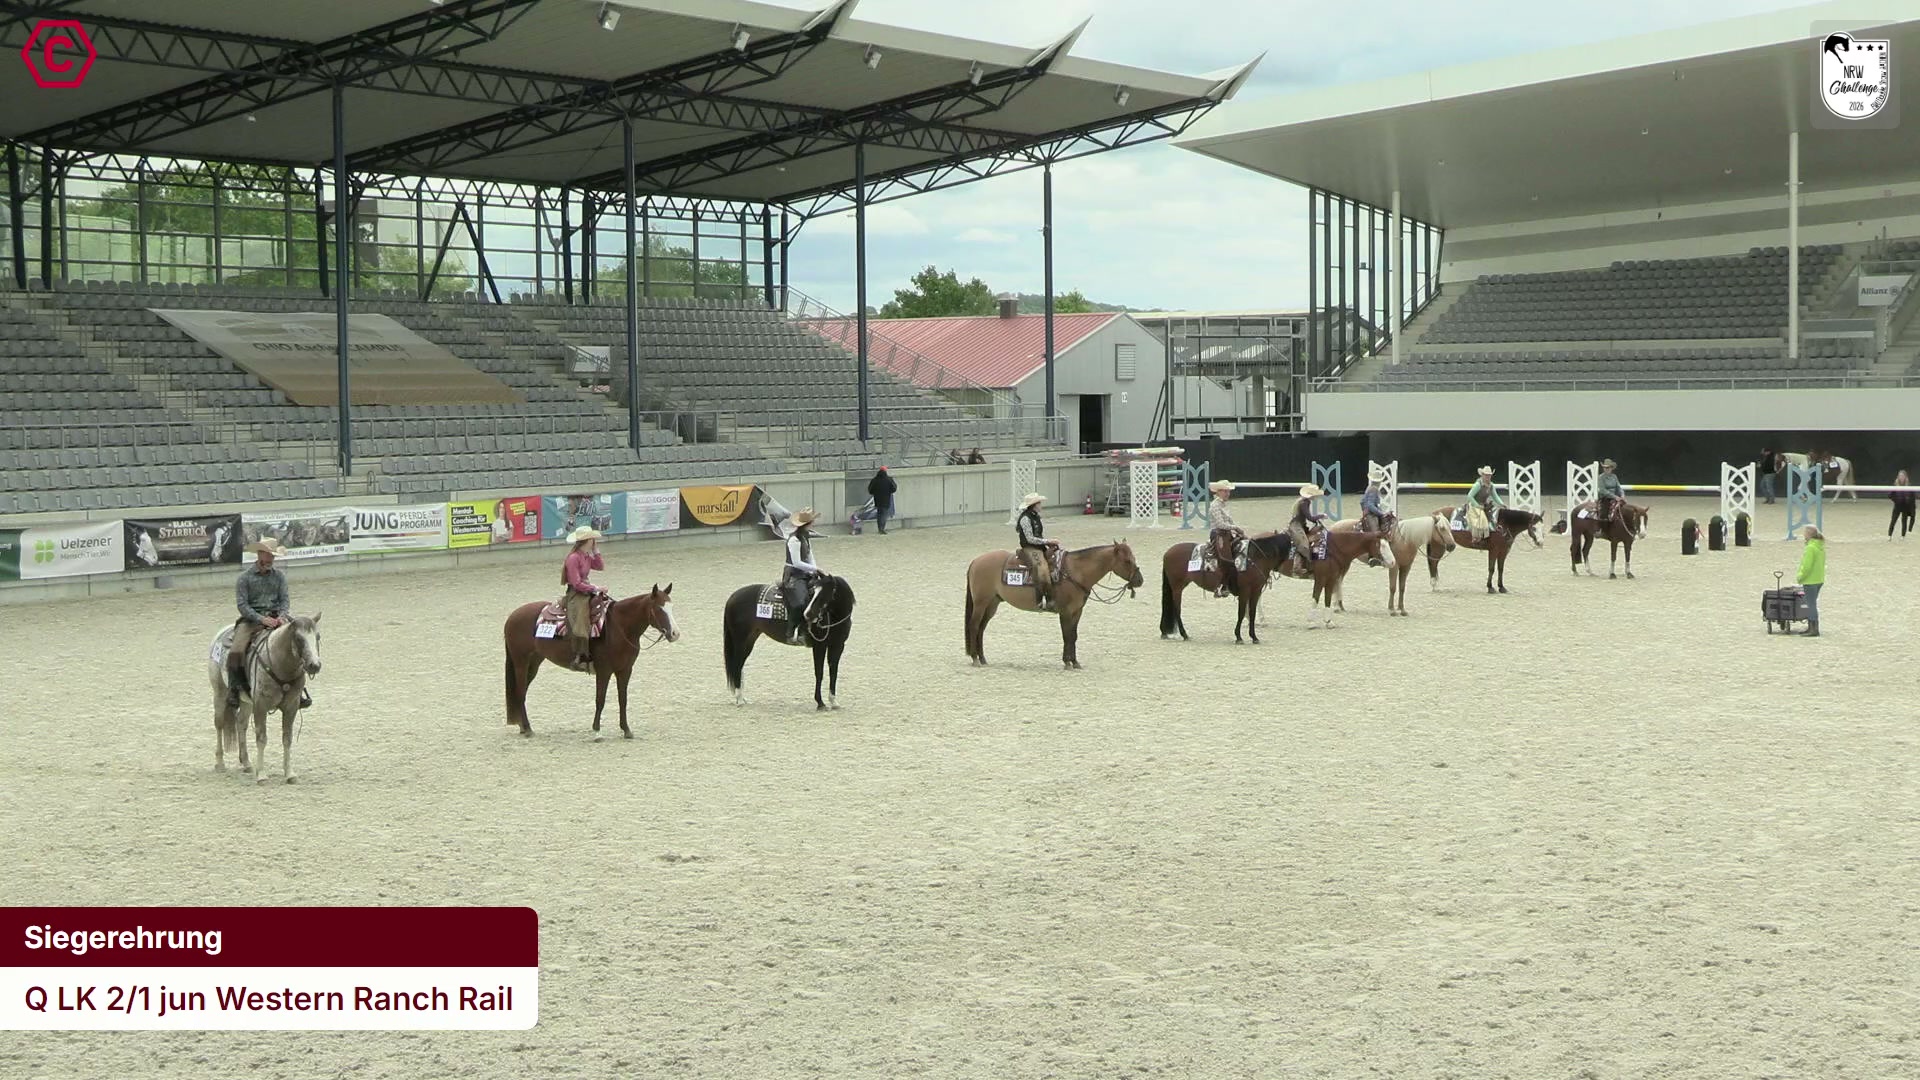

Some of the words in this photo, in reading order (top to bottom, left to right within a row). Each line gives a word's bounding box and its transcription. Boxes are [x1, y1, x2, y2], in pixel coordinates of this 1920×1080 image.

[1861, 287, 1888, 295] Allianz
[252, 342, 292, 351] CHIO
[696, 500, 735, 514] marstall
[400, 511, 427, 520] PFERDE
[352, 512, 399, 530] JUNG
[400, 519, 442, 529] PROGRAMM
[159, 526, 208, 538] STARBUCK
[61, 537, 112, 550] Uelzener
[1009, 574, 1021, 582] 345
